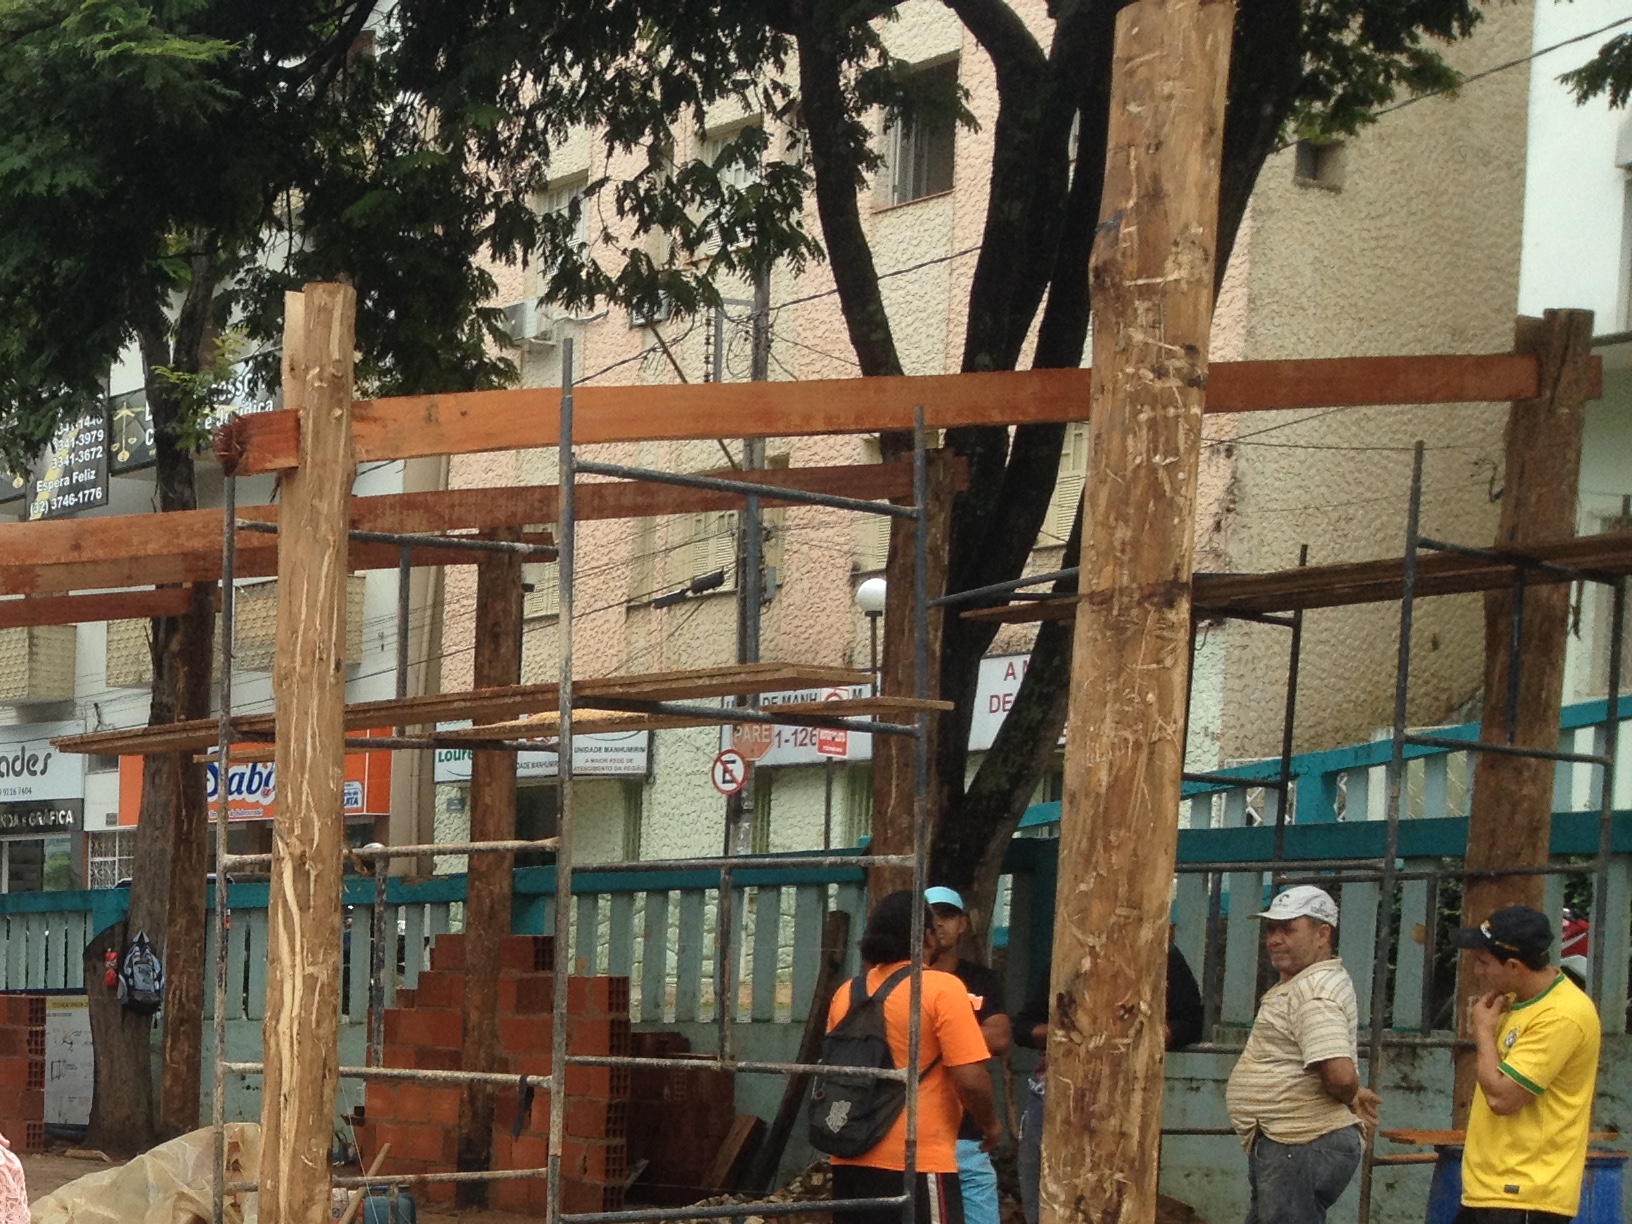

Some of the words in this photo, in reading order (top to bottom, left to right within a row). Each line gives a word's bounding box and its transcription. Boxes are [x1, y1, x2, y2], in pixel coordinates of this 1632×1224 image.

[51, 446, 103, 469] 3341-3672
[36, 476, 70, 493] Espera
[72, 468, 96, 484] Feliz
[29, 500, 49, 516] (32)
[51, 486, 103, 510] 3746-1776
[989, 693, 1013, 713] DE
[734, 724, 770, 743] PARE
